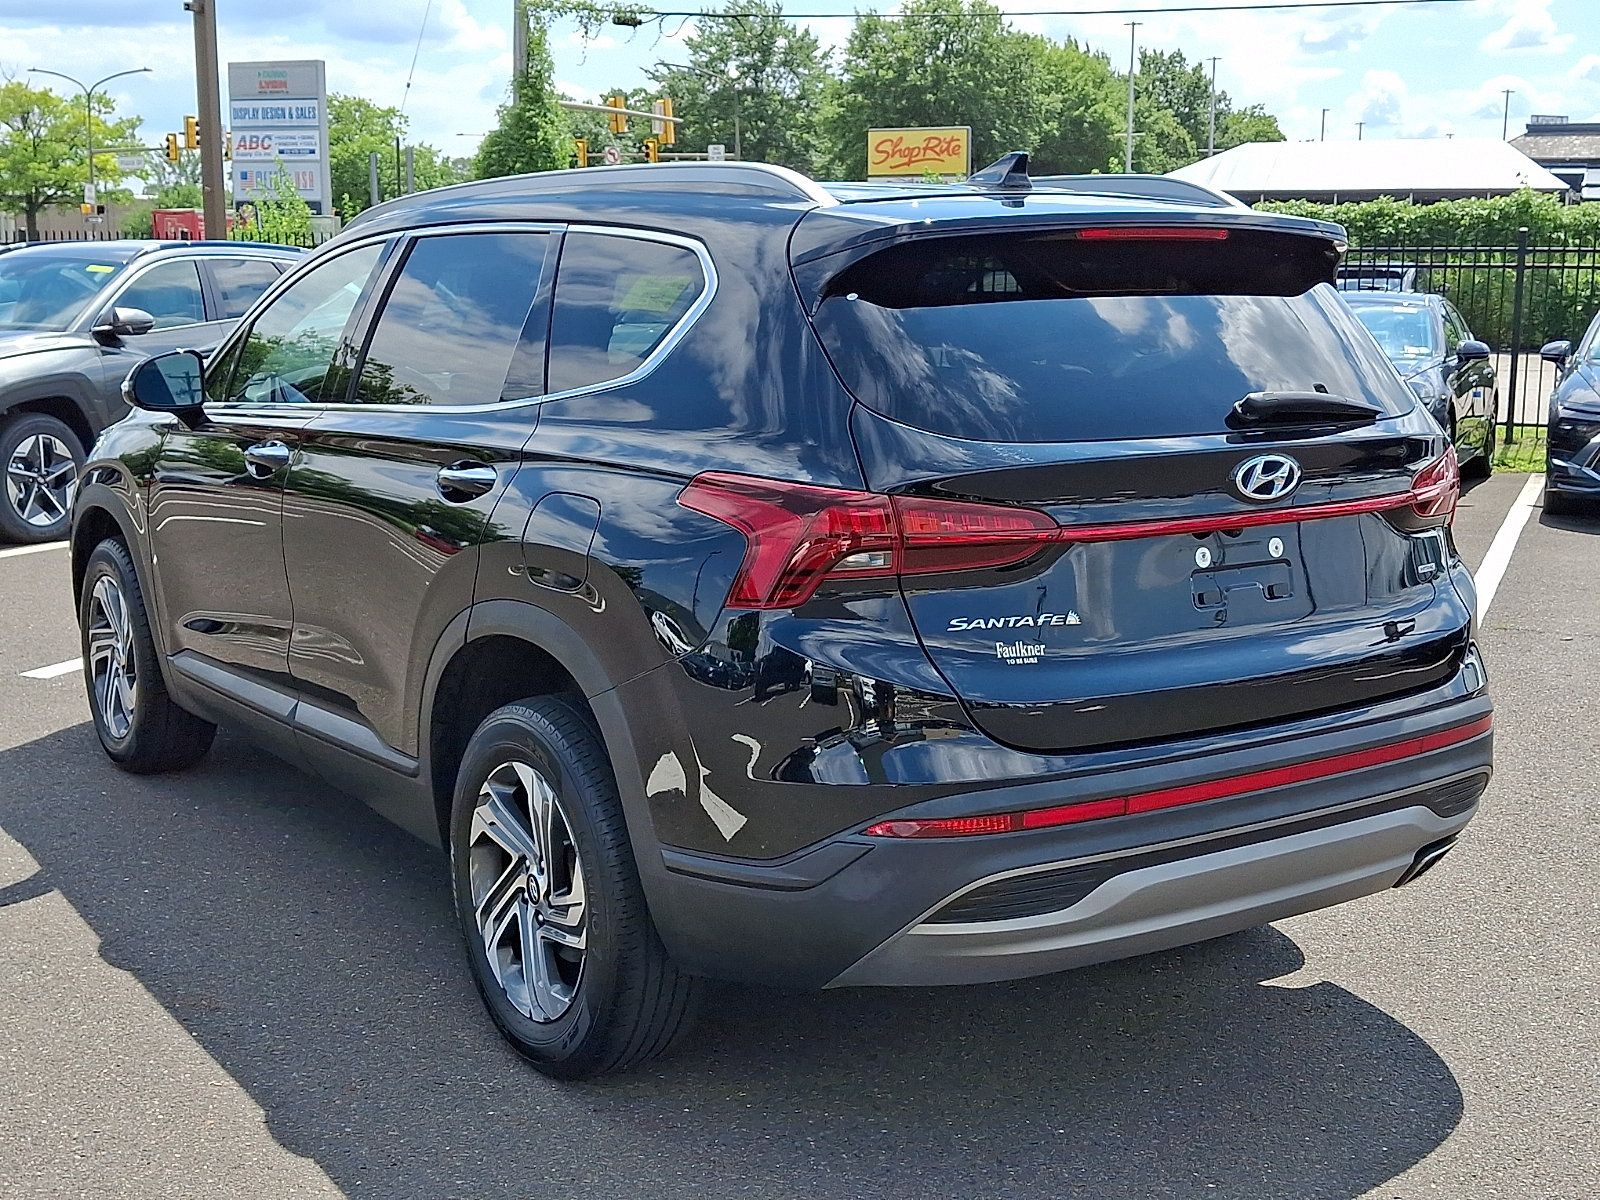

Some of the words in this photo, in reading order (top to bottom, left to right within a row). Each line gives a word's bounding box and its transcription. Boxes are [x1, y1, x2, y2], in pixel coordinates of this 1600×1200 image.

[232, 107, 259, 120] DISPLAY
[262, 106, 286, 120] DESIGN
[288, 106, 294, 120] &
[295, 106, 317, 119] SALES
[236, 134, 273, 150] ABC
[872, 136, 962, 168] ShopRite
[946, 617, 1035, 632] SANTA
[1036, 613, 1066, 627] FE
[995, 641, 1046, 658] Faulkner
